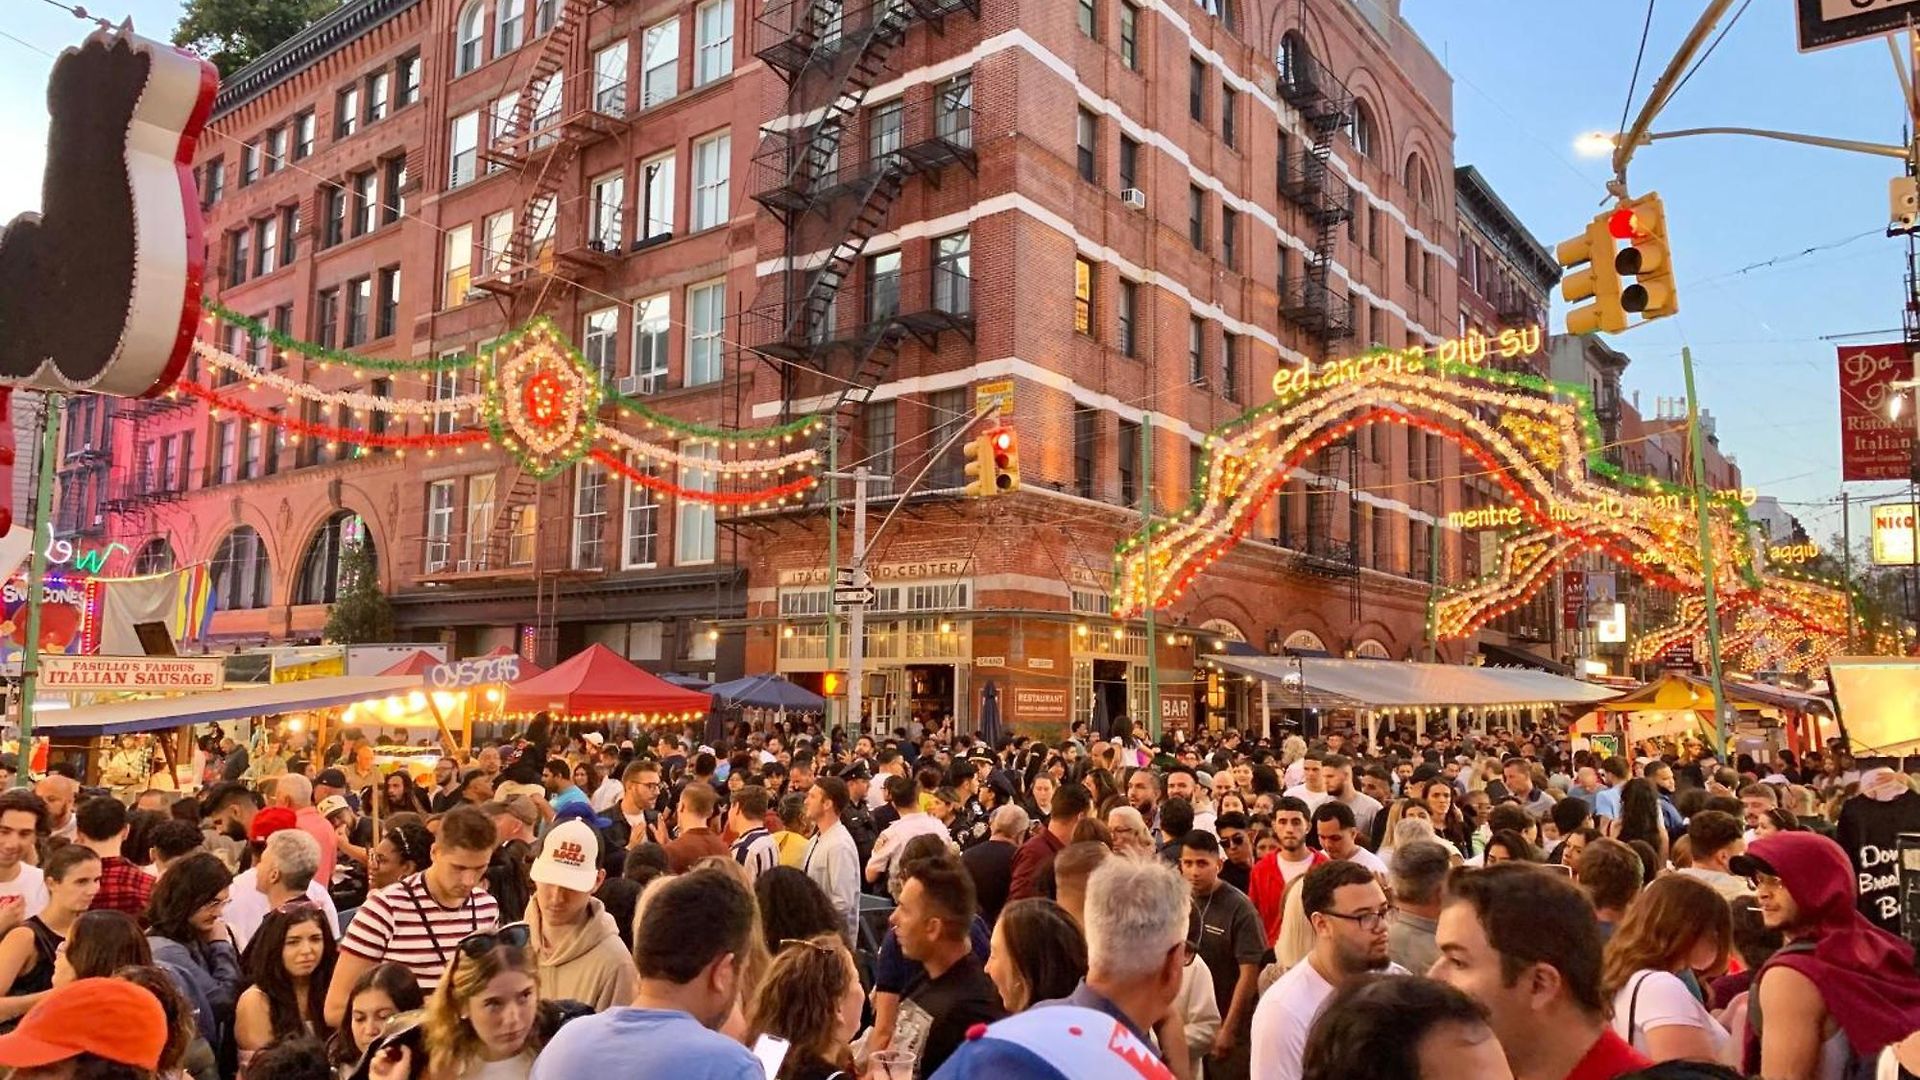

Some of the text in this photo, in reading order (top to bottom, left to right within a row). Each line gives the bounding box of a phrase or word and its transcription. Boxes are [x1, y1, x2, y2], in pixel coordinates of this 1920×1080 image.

[1272, 357, 1310, 395] ed
[1500, 325, 1540, 358] su
[1844, 351, 1893, 386] Da
[1855, 435, 1911, 450] Italian
[1448, 504, 1522, 528] mentre
[1876, 515, 1914, 529] NICO
[898, 562, 959, 577] CENTER
[72, 661, 195, 673] FASULLO'S FAMOUS
[49, 671, 214, 685] ITALIAN SAUSAGE
[1017, 693, 1064, 703] RESTAURANT
[1162, 699, 1189, 717] BAR
